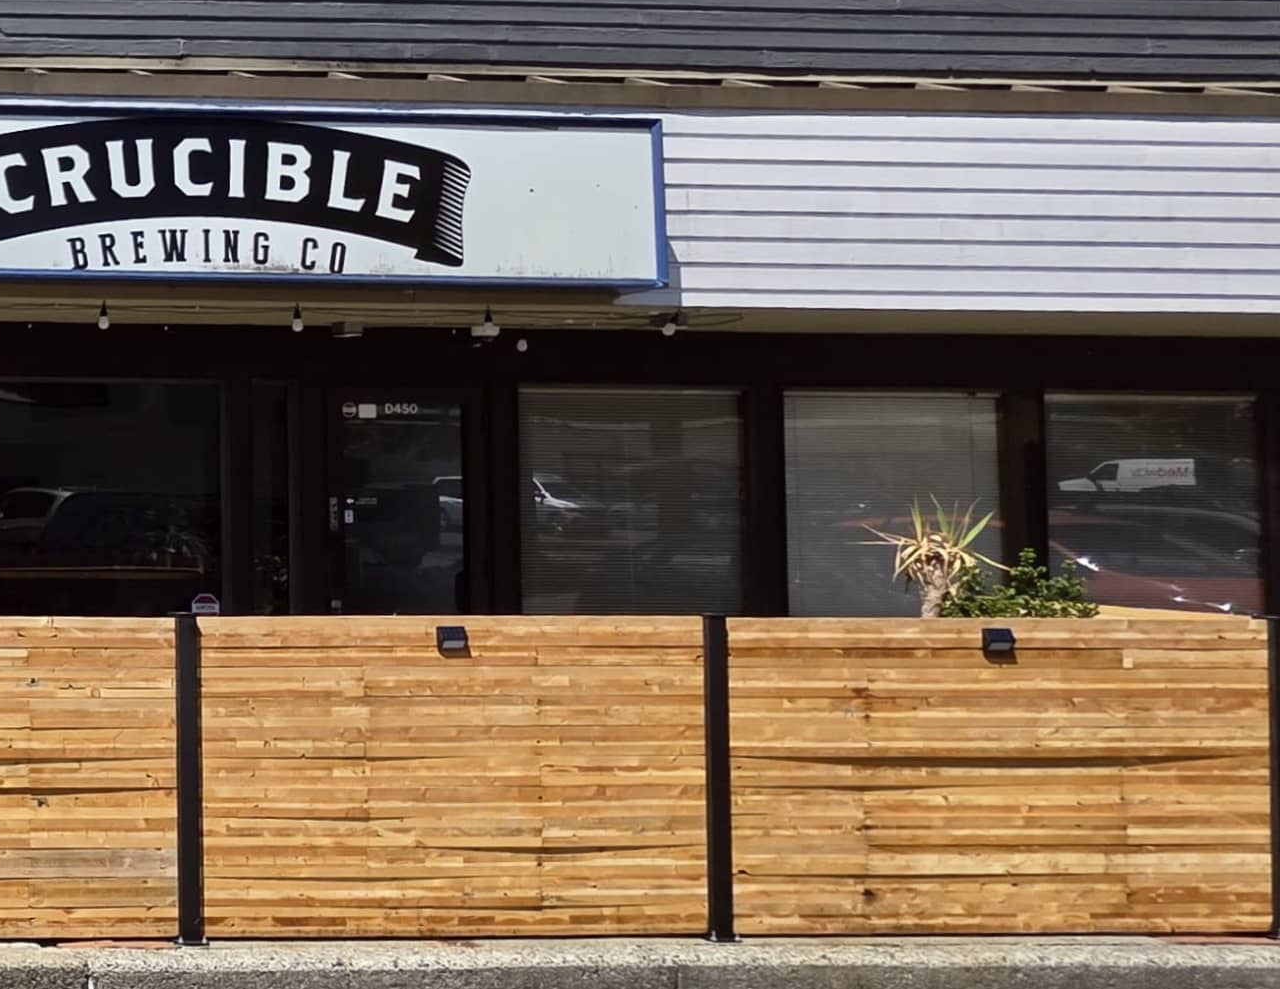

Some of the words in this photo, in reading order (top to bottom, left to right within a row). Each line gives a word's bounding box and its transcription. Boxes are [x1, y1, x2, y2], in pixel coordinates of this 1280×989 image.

[67, 227, 272, 272] BREWING
[300, 239, 347, 275] CO
[384, 403, 418, 415] D450
